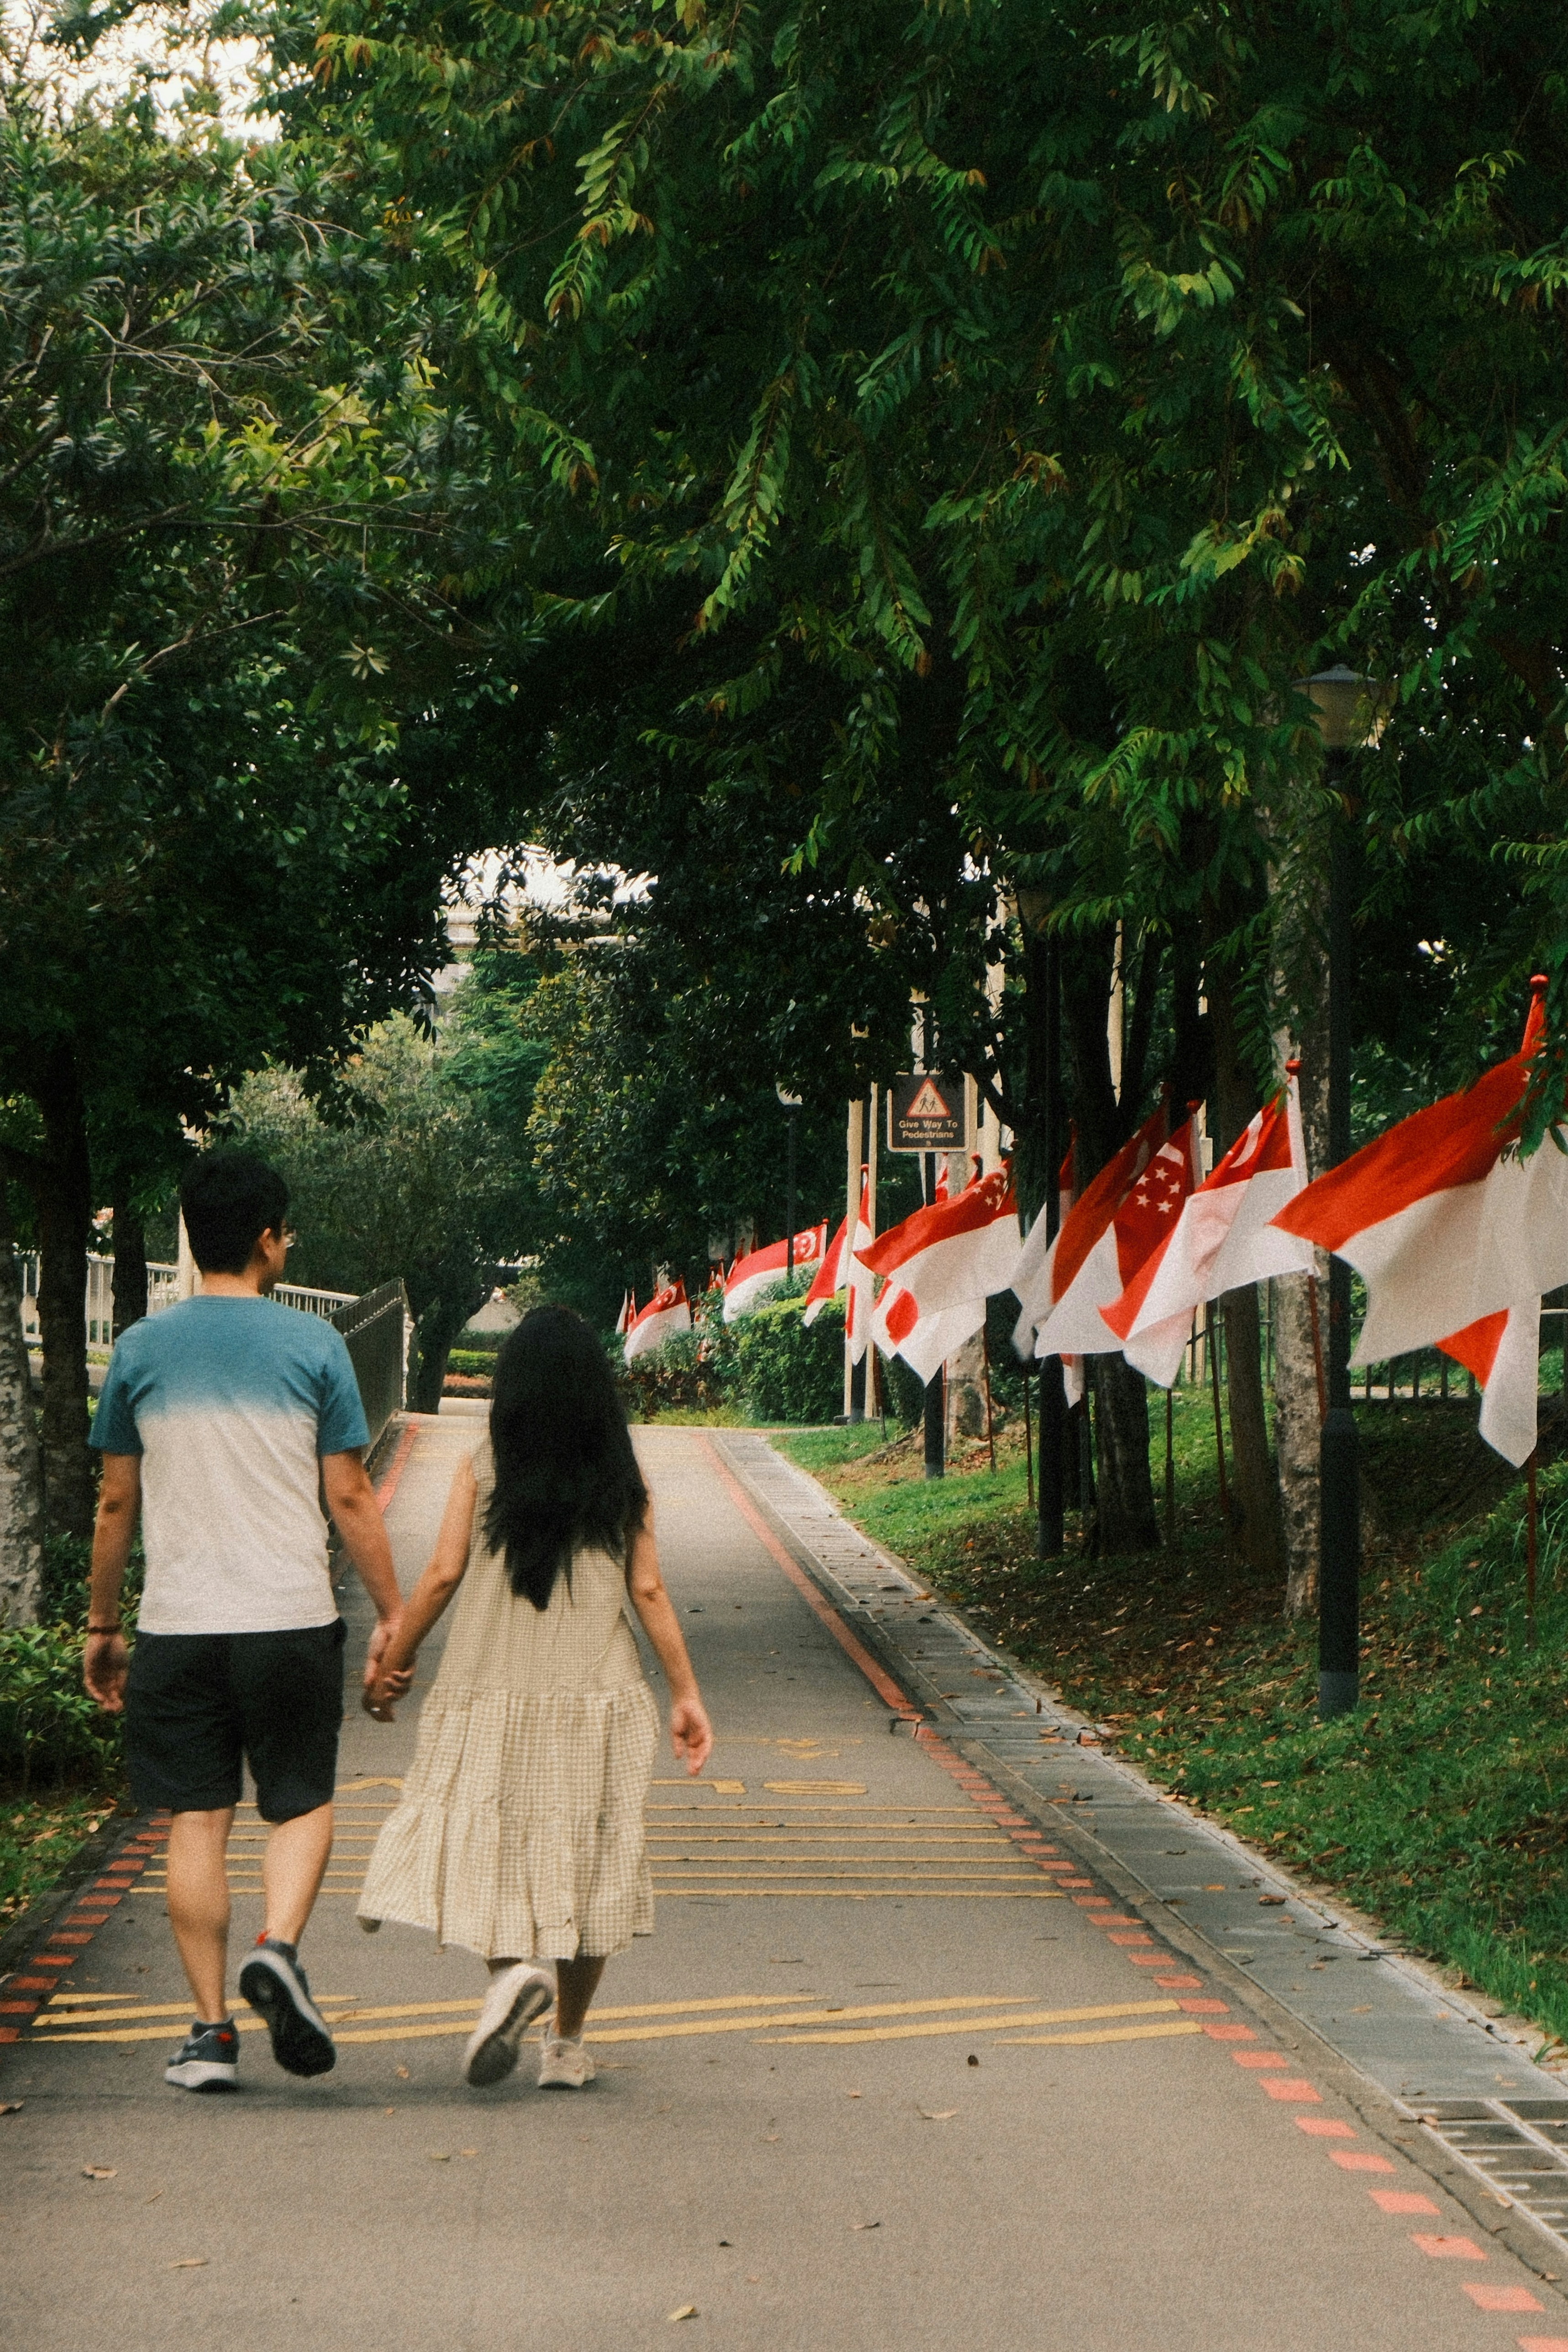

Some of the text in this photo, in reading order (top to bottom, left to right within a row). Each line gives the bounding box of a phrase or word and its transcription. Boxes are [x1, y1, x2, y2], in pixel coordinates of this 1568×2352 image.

[899, 1120, 958, 1129] Give Way To
[902, 1130, 954, 1139] Pedestrians
